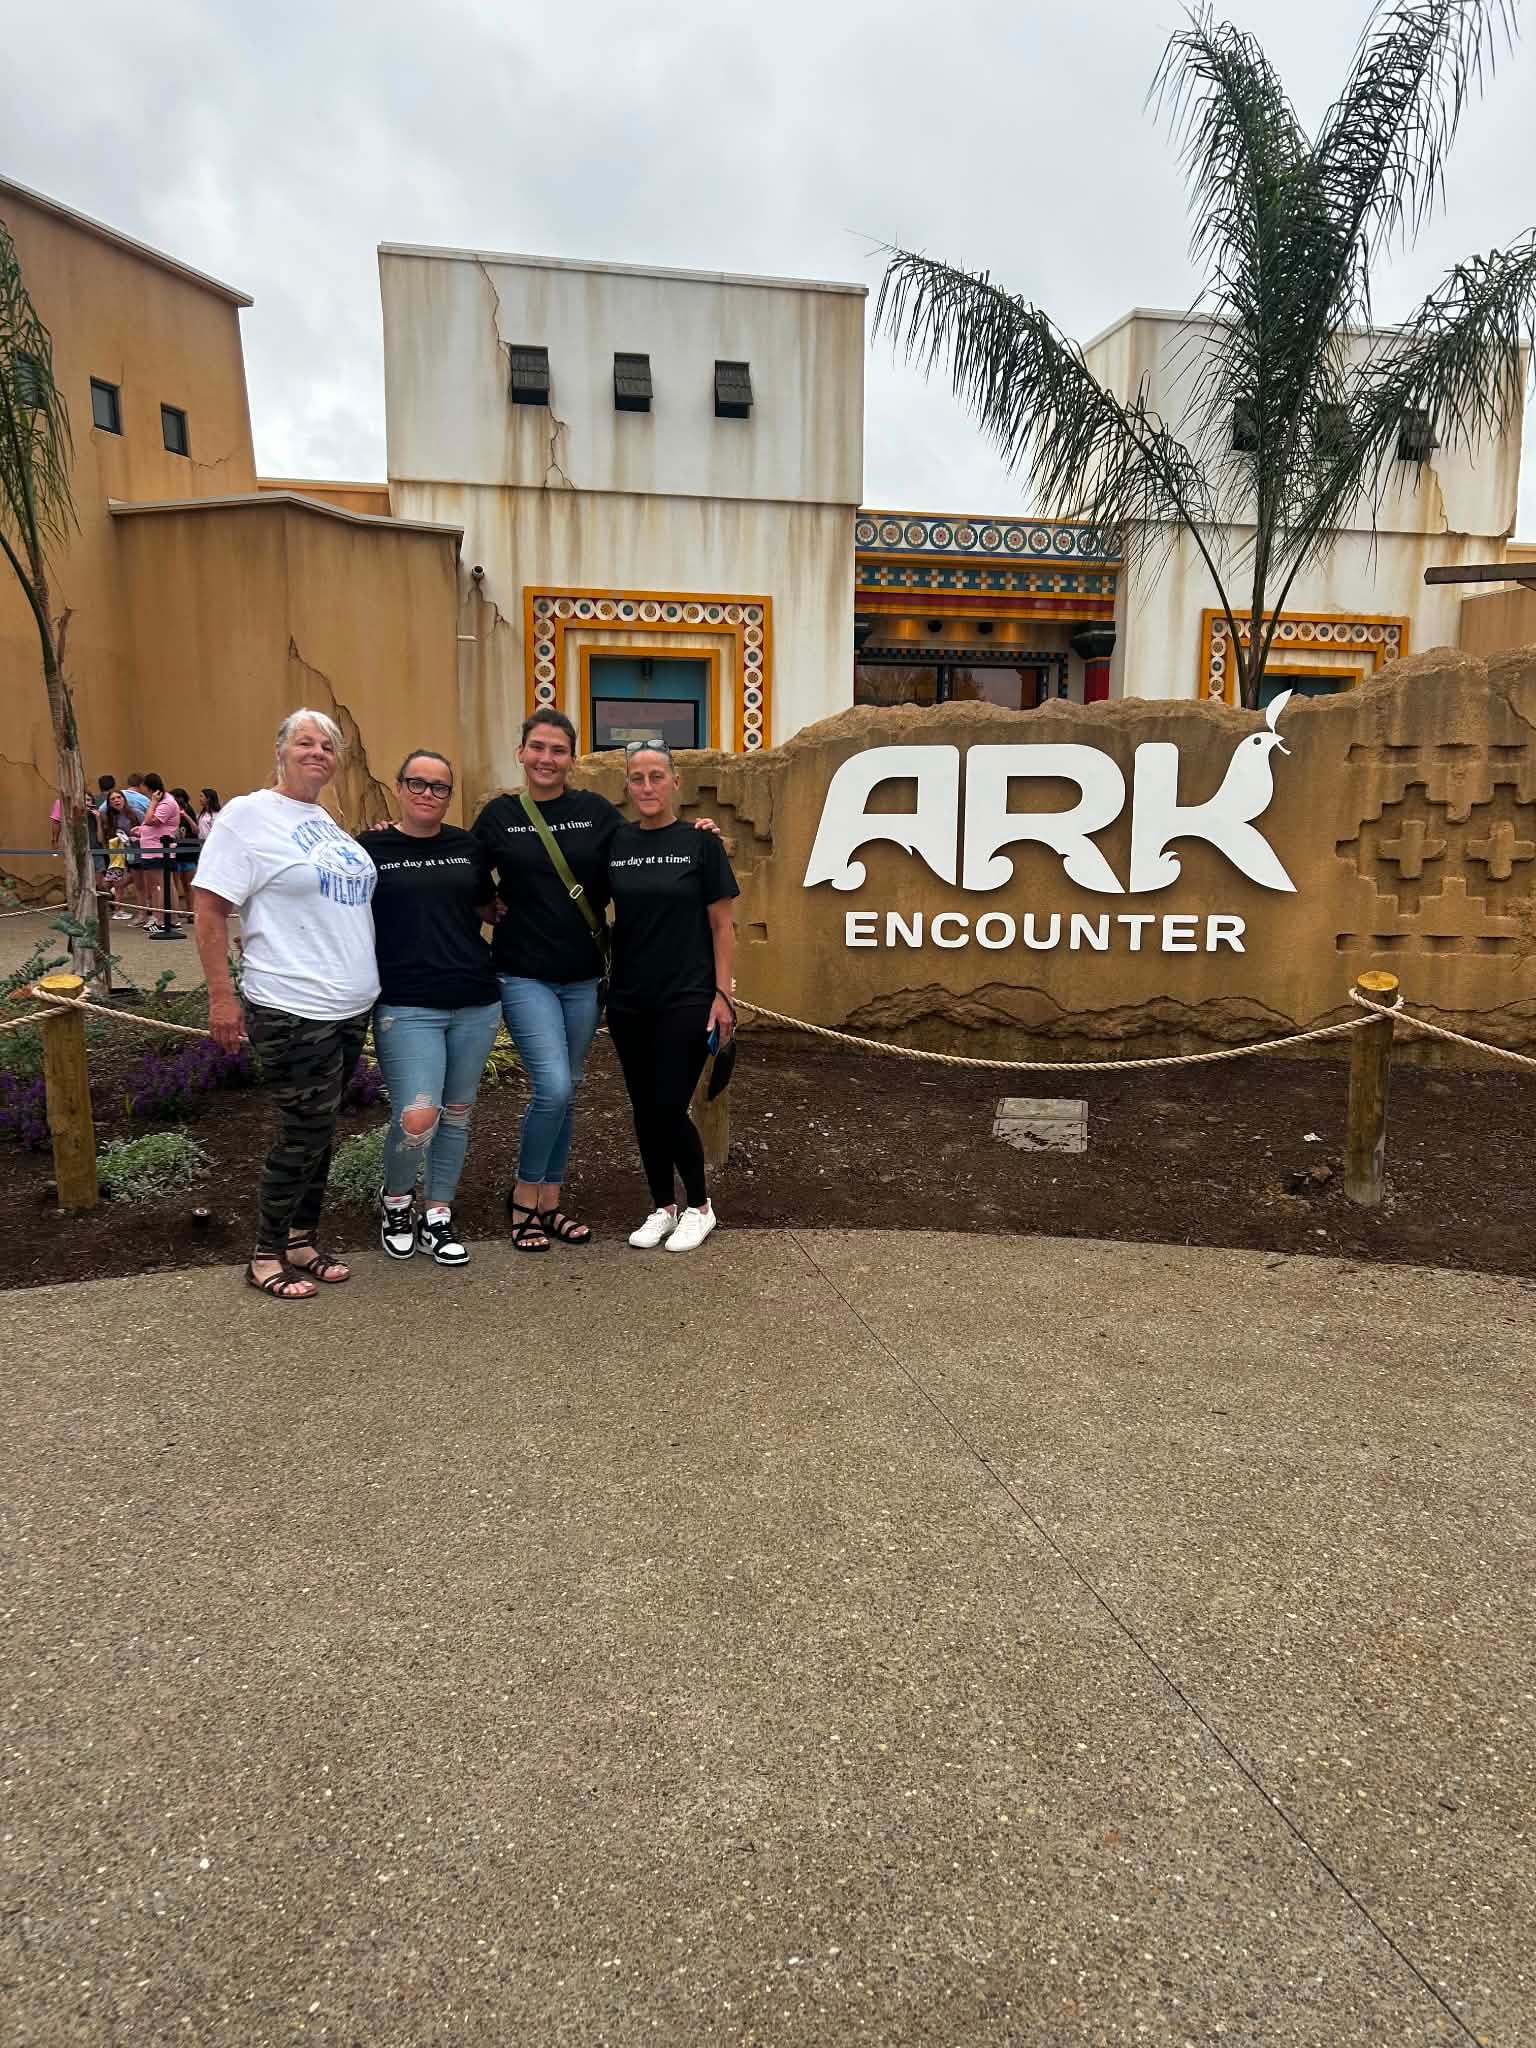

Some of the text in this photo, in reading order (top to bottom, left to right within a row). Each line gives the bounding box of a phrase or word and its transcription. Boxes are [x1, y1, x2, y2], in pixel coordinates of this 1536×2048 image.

[802, 730, 1298, 894] ARK
[507, 825, 527, 833] one
[379, 862, 401, 870] one
[402, 859, 423, 868] day
[610, 859, 626, 867] one
[627, 856, 645, 867] day
[645, 856, 656, 864] at
[844, 911, 1247, 953] ENCOUNTER
